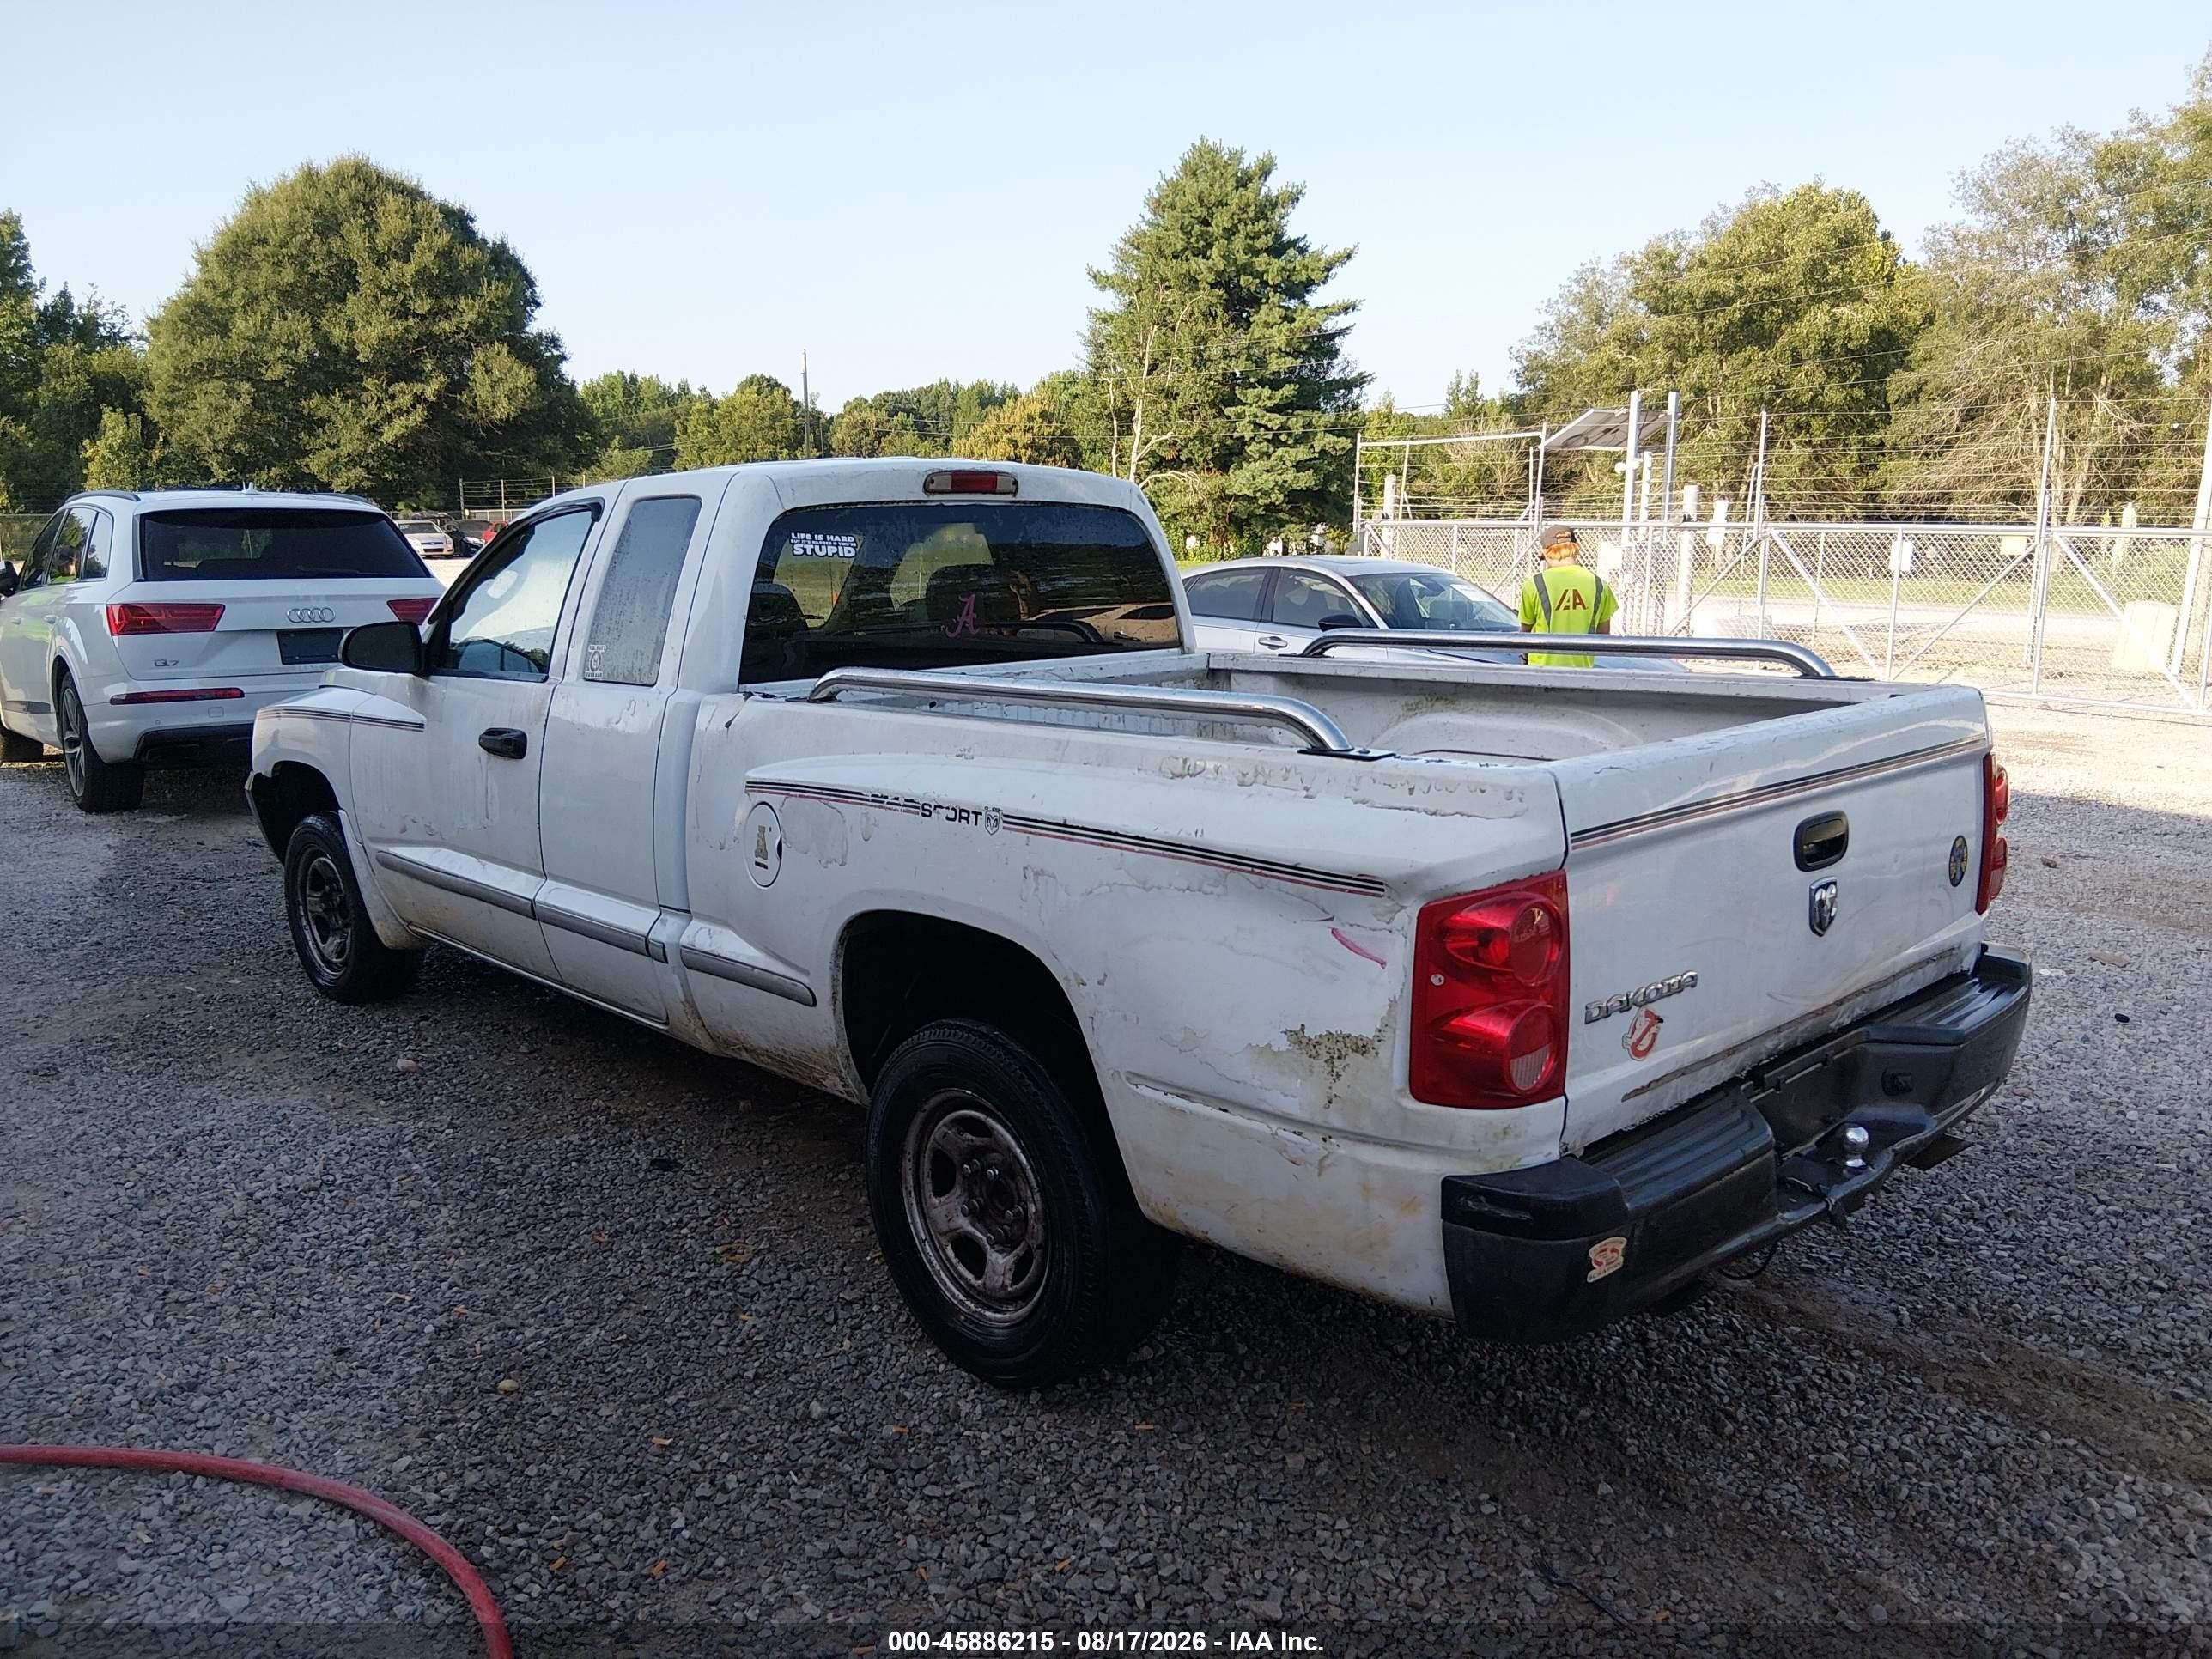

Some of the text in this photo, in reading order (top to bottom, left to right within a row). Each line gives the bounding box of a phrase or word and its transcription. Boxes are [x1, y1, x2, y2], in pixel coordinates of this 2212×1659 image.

[793, 544, 856, 557] STUPID
[154, 659, 179, 667] Q7
[1584, 969, 1698, 1025] DAKOTA
